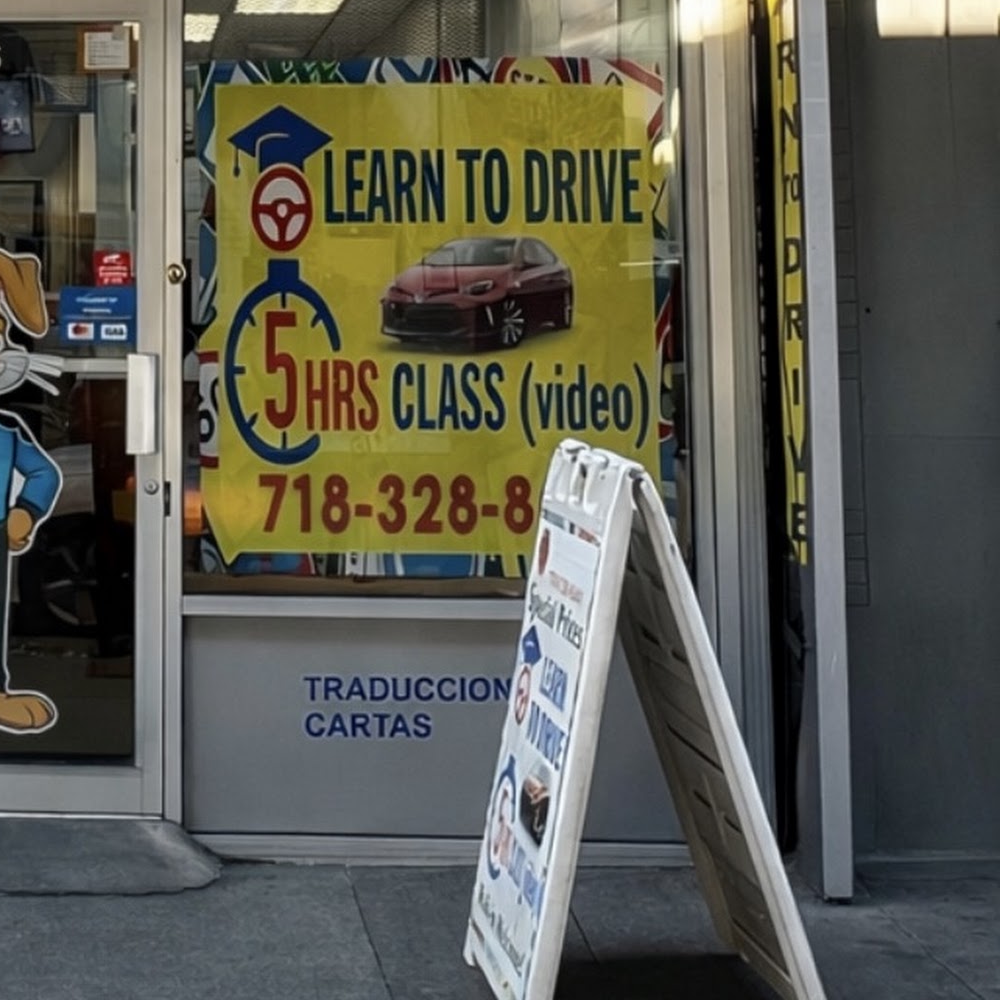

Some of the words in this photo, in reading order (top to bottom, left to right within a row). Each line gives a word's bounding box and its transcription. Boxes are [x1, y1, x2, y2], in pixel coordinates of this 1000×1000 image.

[323, 148, 446, 224] LEARN
[456, 147, 509, 224] TO
[524, 148, 644, 224] DRIVE
[264, 310, 298, 430] 5
[305, 359, 380, 432] HRS
[391, 361, 506, 431] CLASS
[520, 361, 650, 448] (video)
[259, 473, 534, 535] 718-328-8
[304, 712, 432, 738] CARTAS
